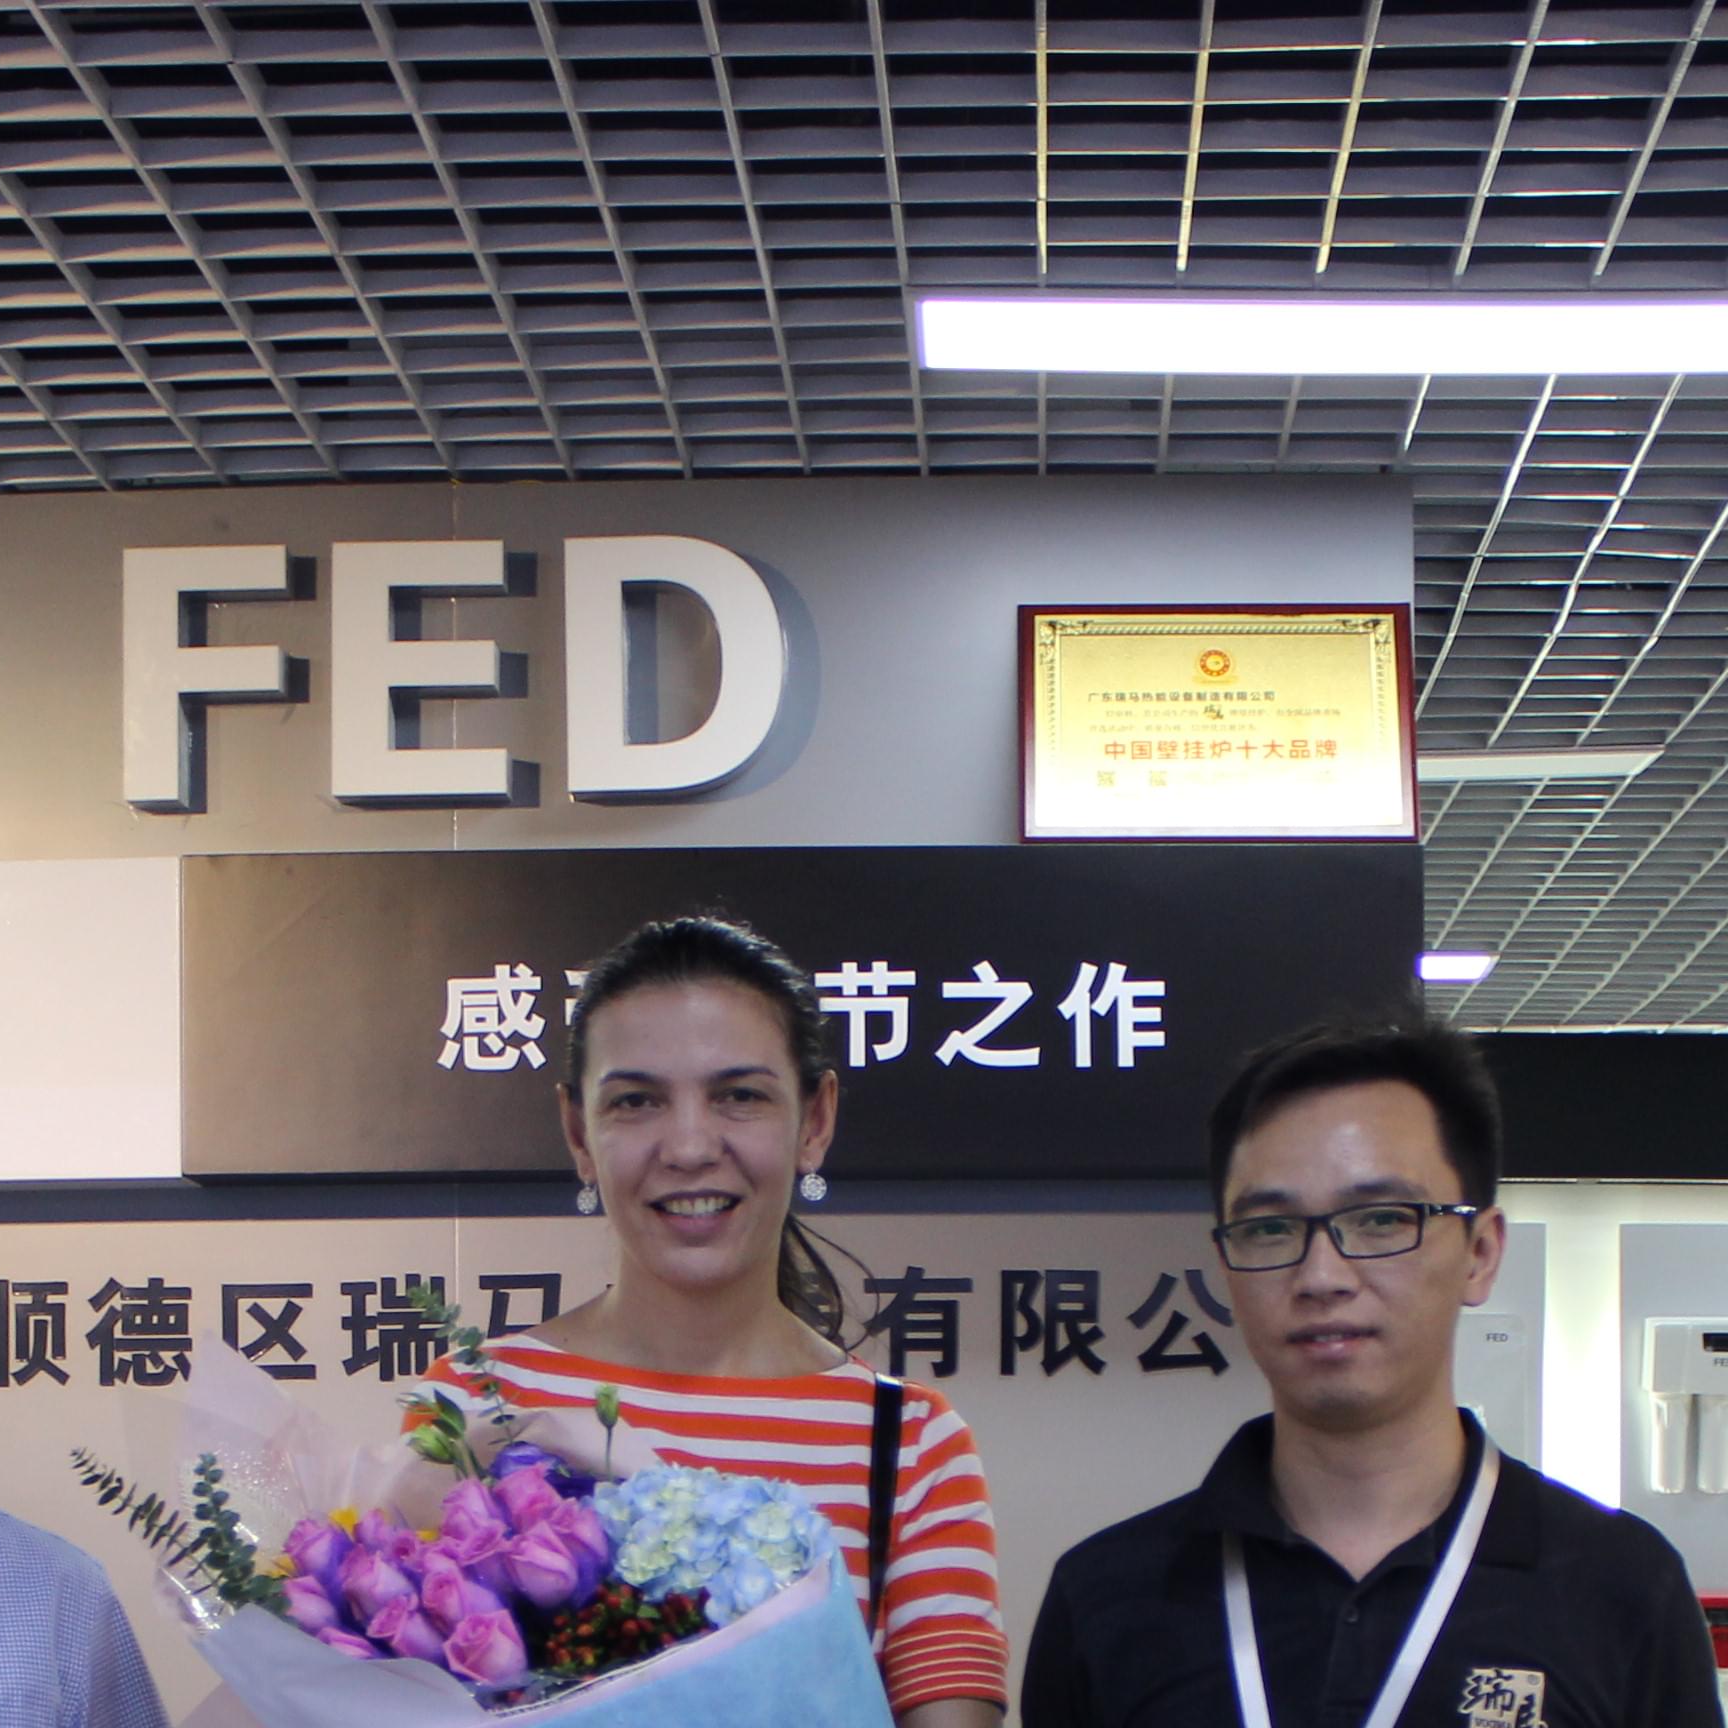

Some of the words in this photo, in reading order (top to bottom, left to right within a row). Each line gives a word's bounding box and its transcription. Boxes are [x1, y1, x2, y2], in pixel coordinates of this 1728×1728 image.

[122, 534, 788, 810] FED
[1103, 739, 1338, 761] 中国壁挂炉十大品牌
[1486, 1332, 1508, 1343] FED
